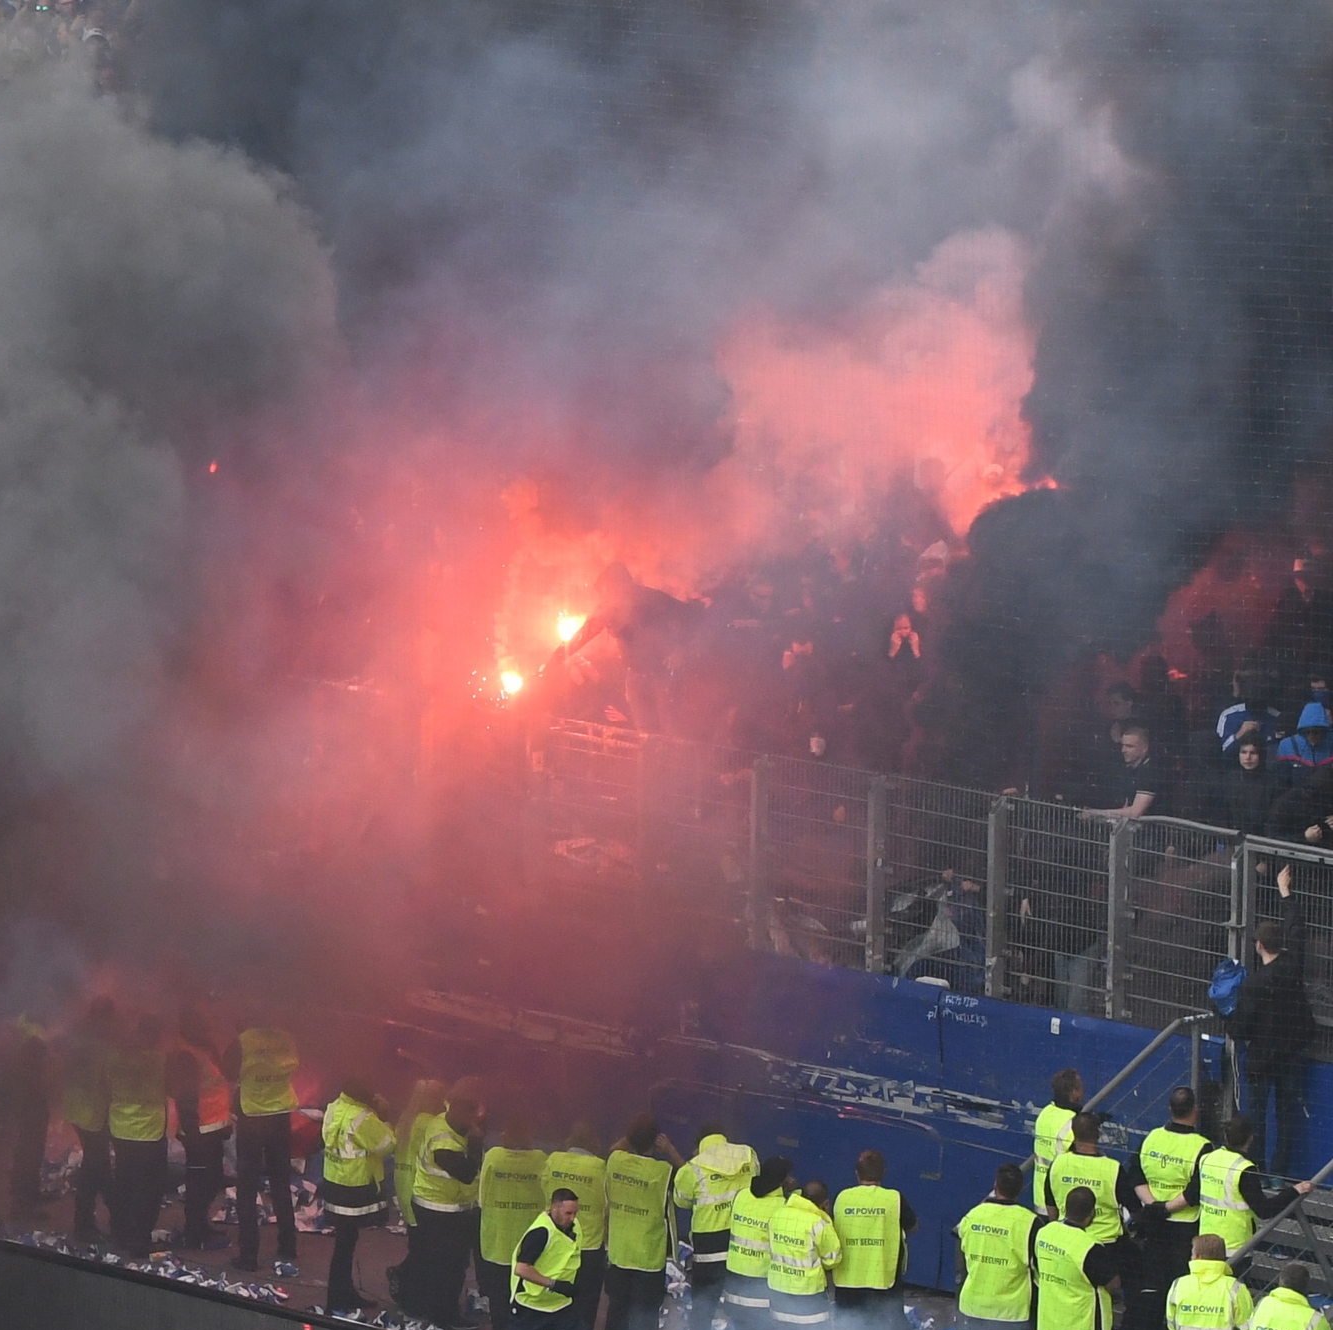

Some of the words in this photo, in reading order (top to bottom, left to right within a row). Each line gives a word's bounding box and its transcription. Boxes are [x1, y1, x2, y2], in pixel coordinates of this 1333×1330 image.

[1073, 1177, 1102, 1188] POWER
[511, 1201, 539, 1211] SECURITY
[856, 1207, 886, 1216] POWER
[982, 1225, 1009, 1237] POWER
[780, 1233, 805, 1246] POWER
[860, 1237, 885, 1246] SECURITY
[981, 1255, 1009, 1267] SECURITY
[1193, 1305, 1224, 1314] POWER
